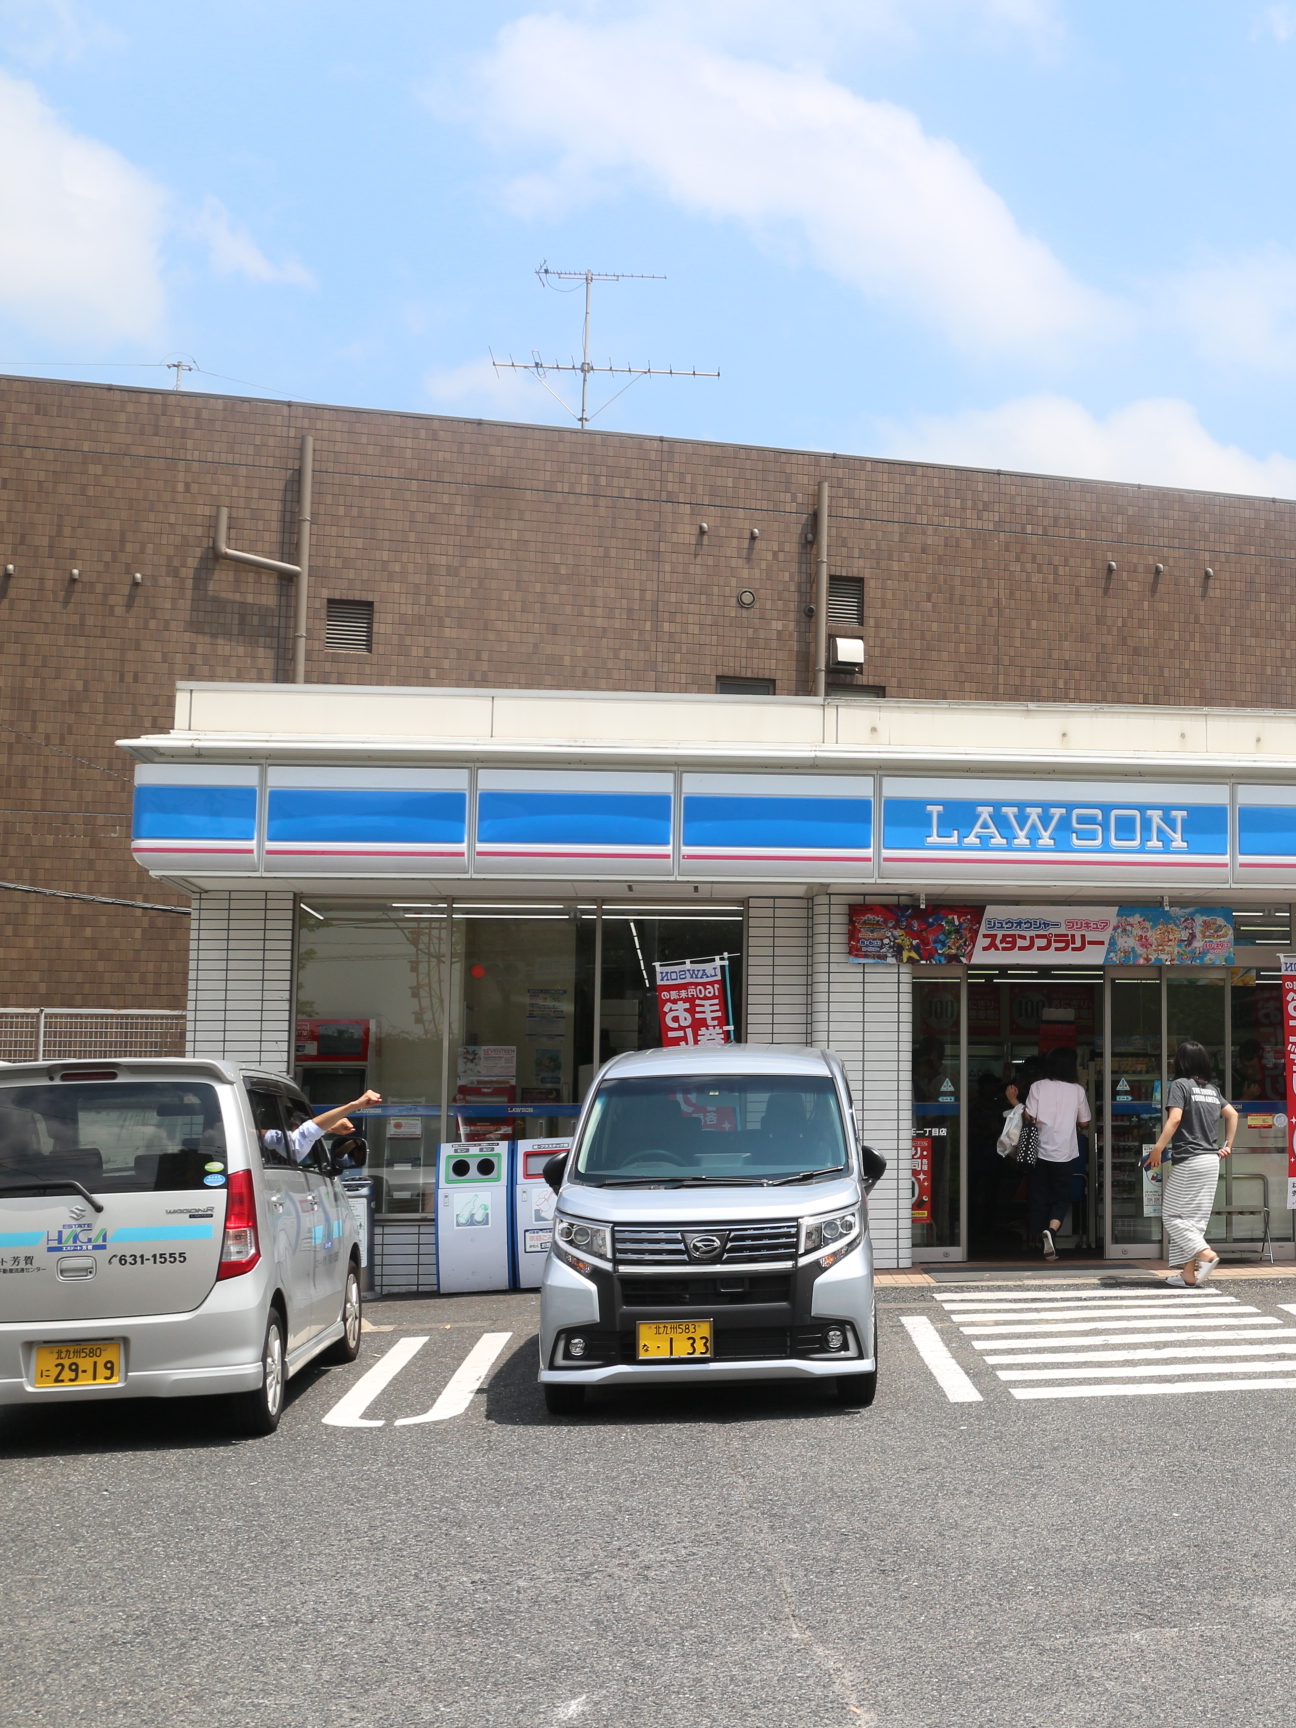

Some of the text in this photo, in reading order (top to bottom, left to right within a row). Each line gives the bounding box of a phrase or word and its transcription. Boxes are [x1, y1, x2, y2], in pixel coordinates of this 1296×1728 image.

[925, 805, 1188, 850] LAWSON
[985, 918, 1110, 931] ジュウオウジャー プリキュア
[982, 933, 1105, 952] スタンプラリー
[46, 1228, 108, 1246] HAGA
[119, 1252, 187, 1266] 631-1555
[653, 1323, 697, 1335] 北九州583
[55, 1347, 102, 1360] 北九州580
[53, 1360, 115, 1383] 29-19
